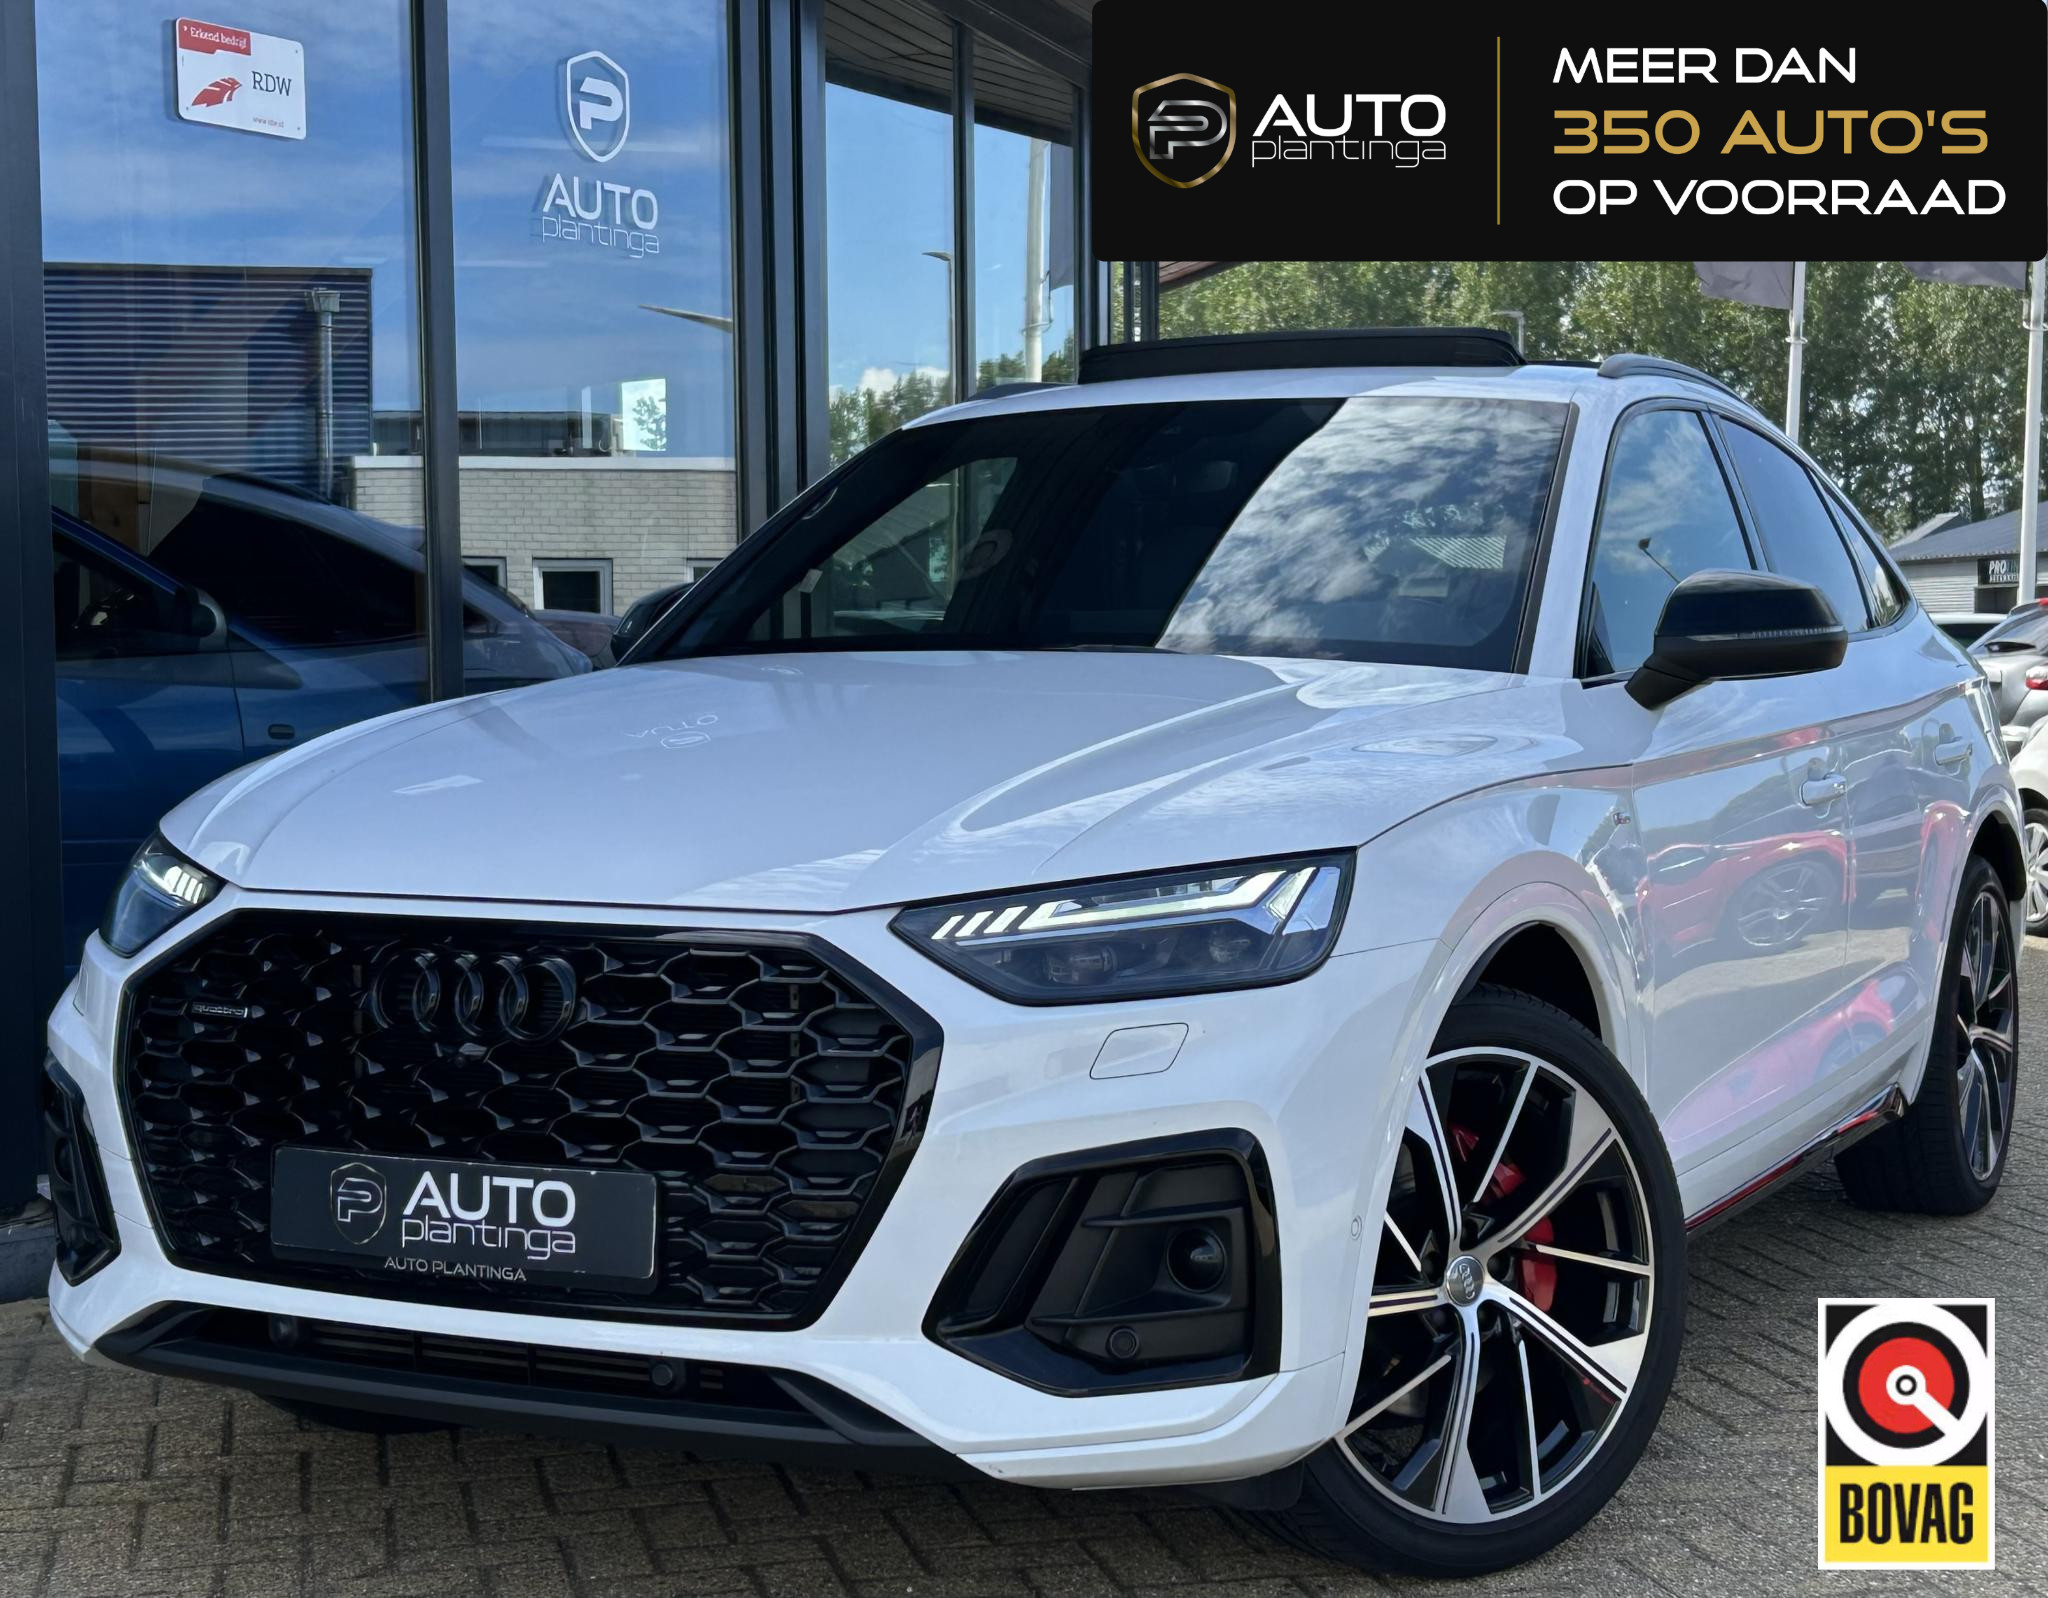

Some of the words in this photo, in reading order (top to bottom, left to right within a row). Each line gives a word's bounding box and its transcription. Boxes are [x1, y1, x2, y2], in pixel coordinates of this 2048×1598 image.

[251, 70, 292, 97] RDW
[543, 173, 658, 230] AUTO
[542, 214, 660, 259] plantinga
[402, 1171, 576, 1228] AUTO
[402, 1214, 576, 1260] plantinga
[384, 1257, 428, 1273] AUTO
[432, 1260, 527, 1282] PLANTINGA
